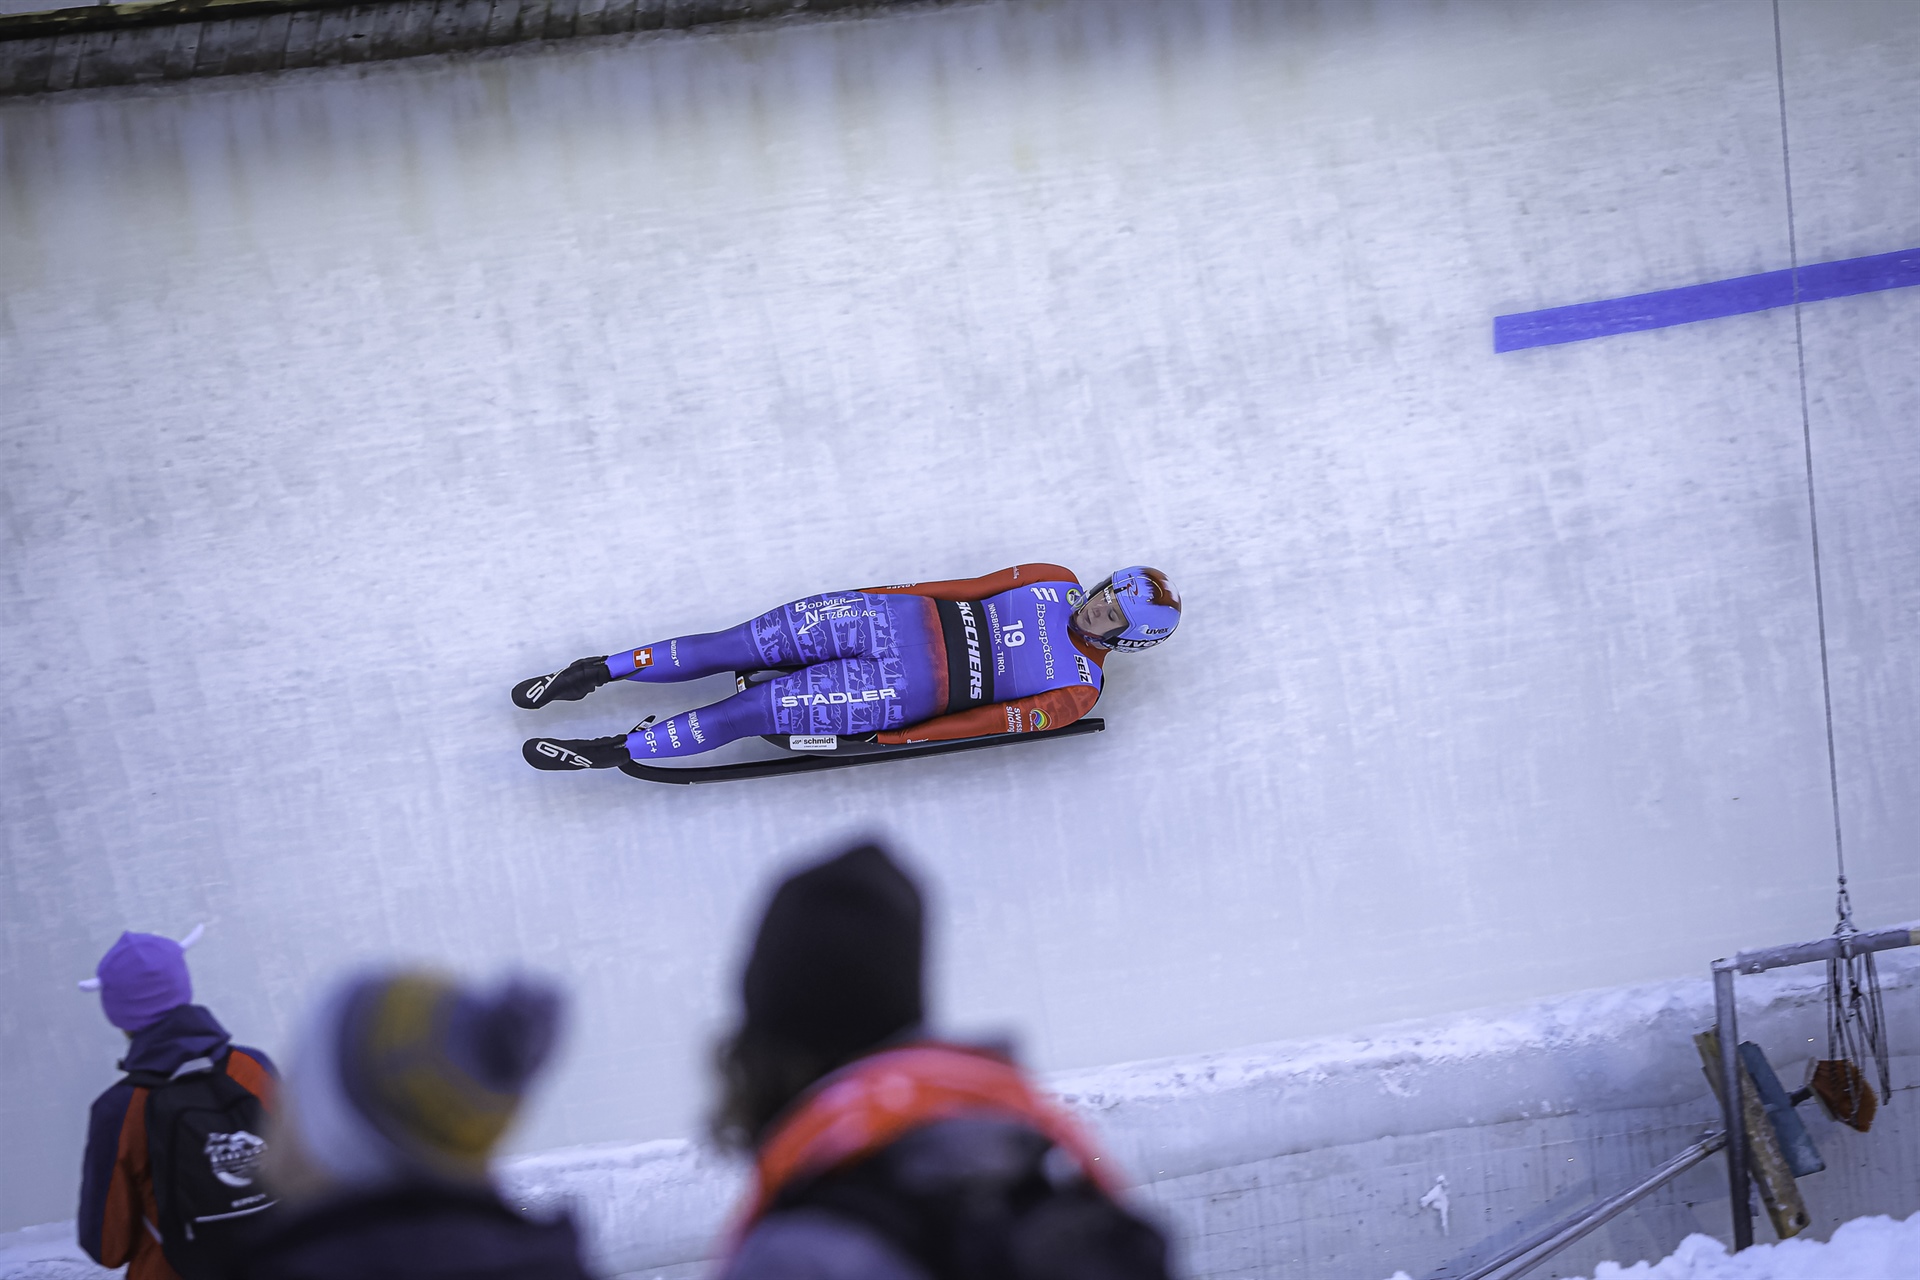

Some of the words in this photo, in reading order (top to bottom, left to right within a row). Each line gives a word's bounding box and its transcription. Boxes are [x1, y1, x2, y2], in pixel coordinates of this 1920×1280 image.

[795, 597, 847, 613] BODMER
[1103, 587, 1112, 604] uvex
[805, 609, 858, 624] NETZBAU
[988, 603, 1002, 645] INNSBRUCK
[997, 651, 1006, 676] TIROL
[1002, 620, 1026, 648] 19
[1035, 603, 1055, 681] Eberspächer
[1117, 637, 1167, 648] uvex
[1145, 627, 1168, 635] uvex
[955, 601, 983, 701] SKECHERS
[526, 669, 564, 703] TS
[781, 689, 897, 708] STADLER
[1006, 706, 1015, 733] sliding
[666, 720, 681, 749] KIBAG
[803, 737, 834, 745] schmidt
[536, 741, 593, 768] GTS
